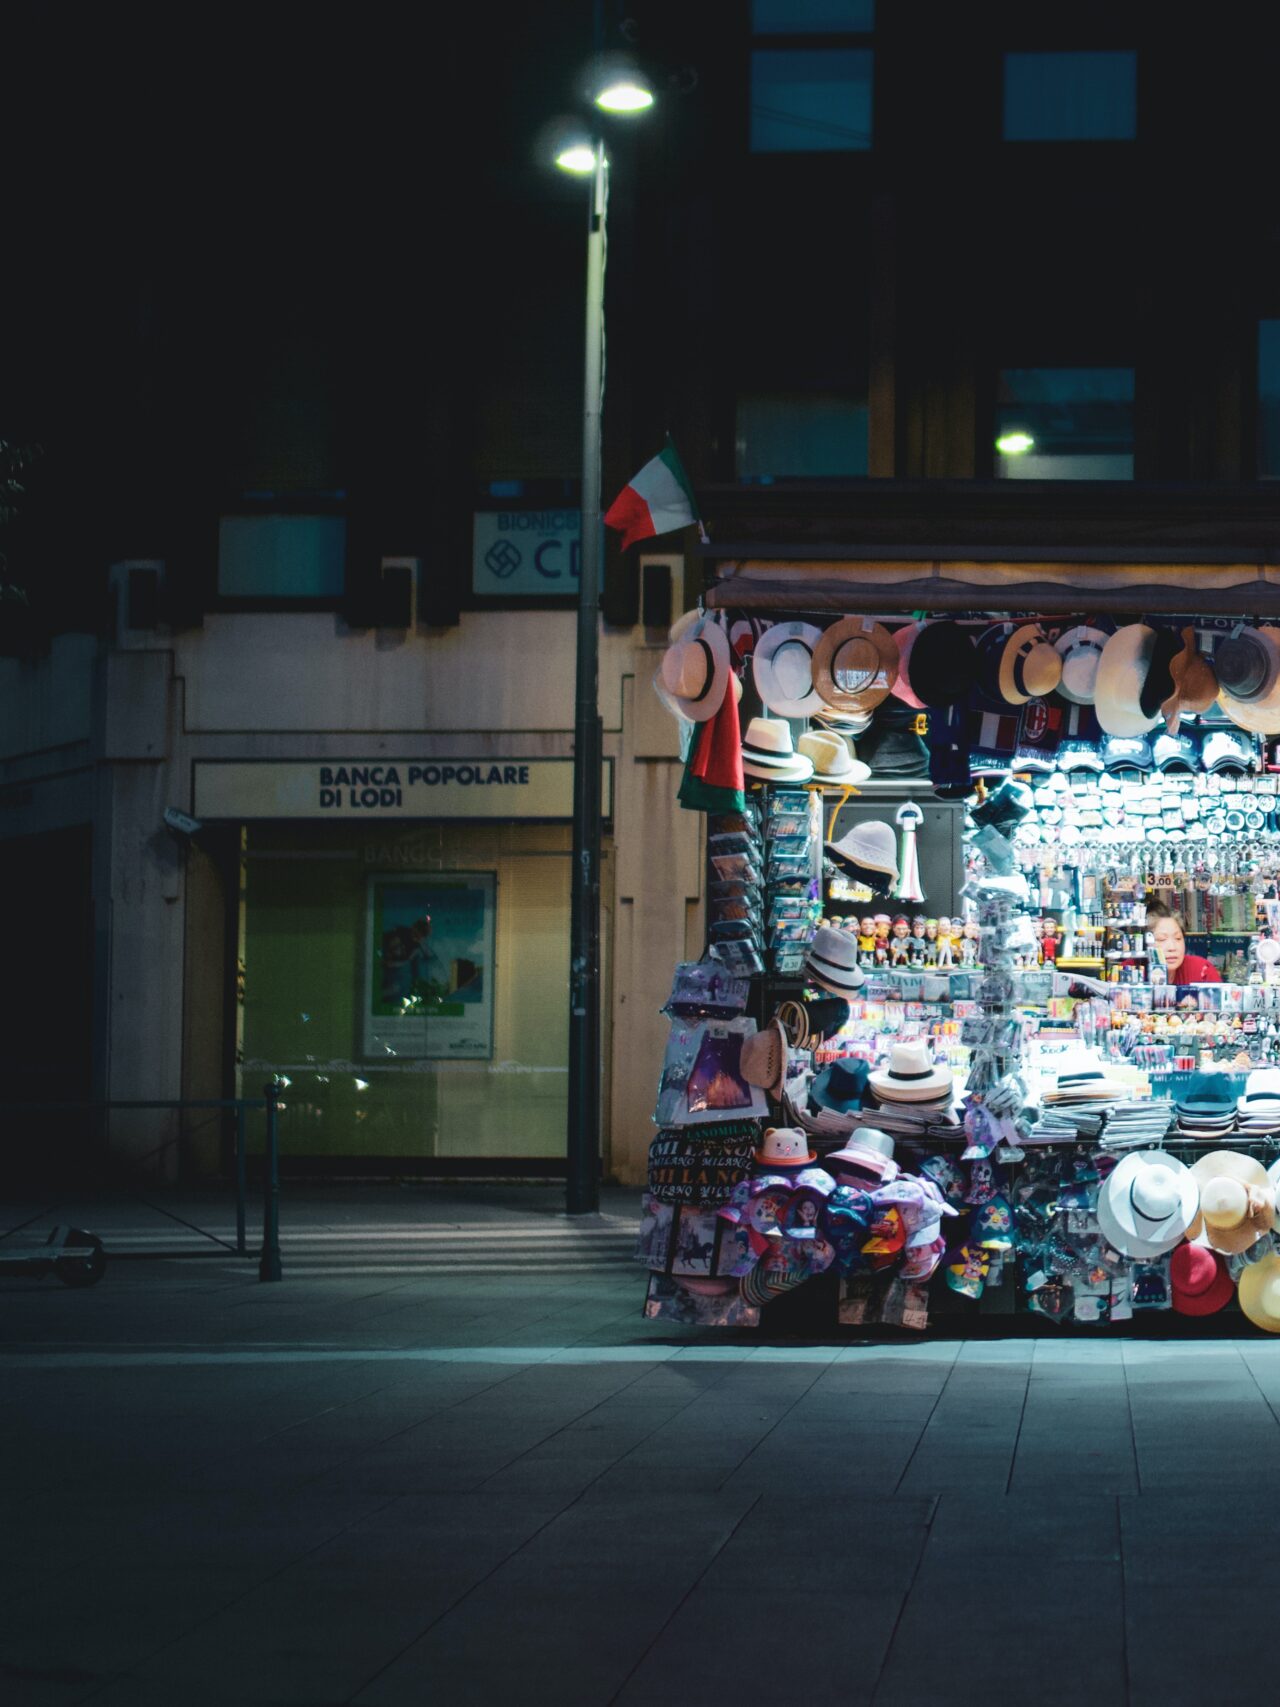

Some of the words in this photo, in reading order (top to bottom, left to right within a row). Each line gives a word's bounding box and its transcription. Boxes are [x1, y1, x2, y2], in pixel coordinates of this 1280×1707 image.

[319, 766, 401, 786] BANCA
[408, 766, 529, 786] POPOLARE
[319, 788, 342, 808] DI
[350, 788, 402, 808] LODI
[1147, 873, 1172, 886] 3,00
